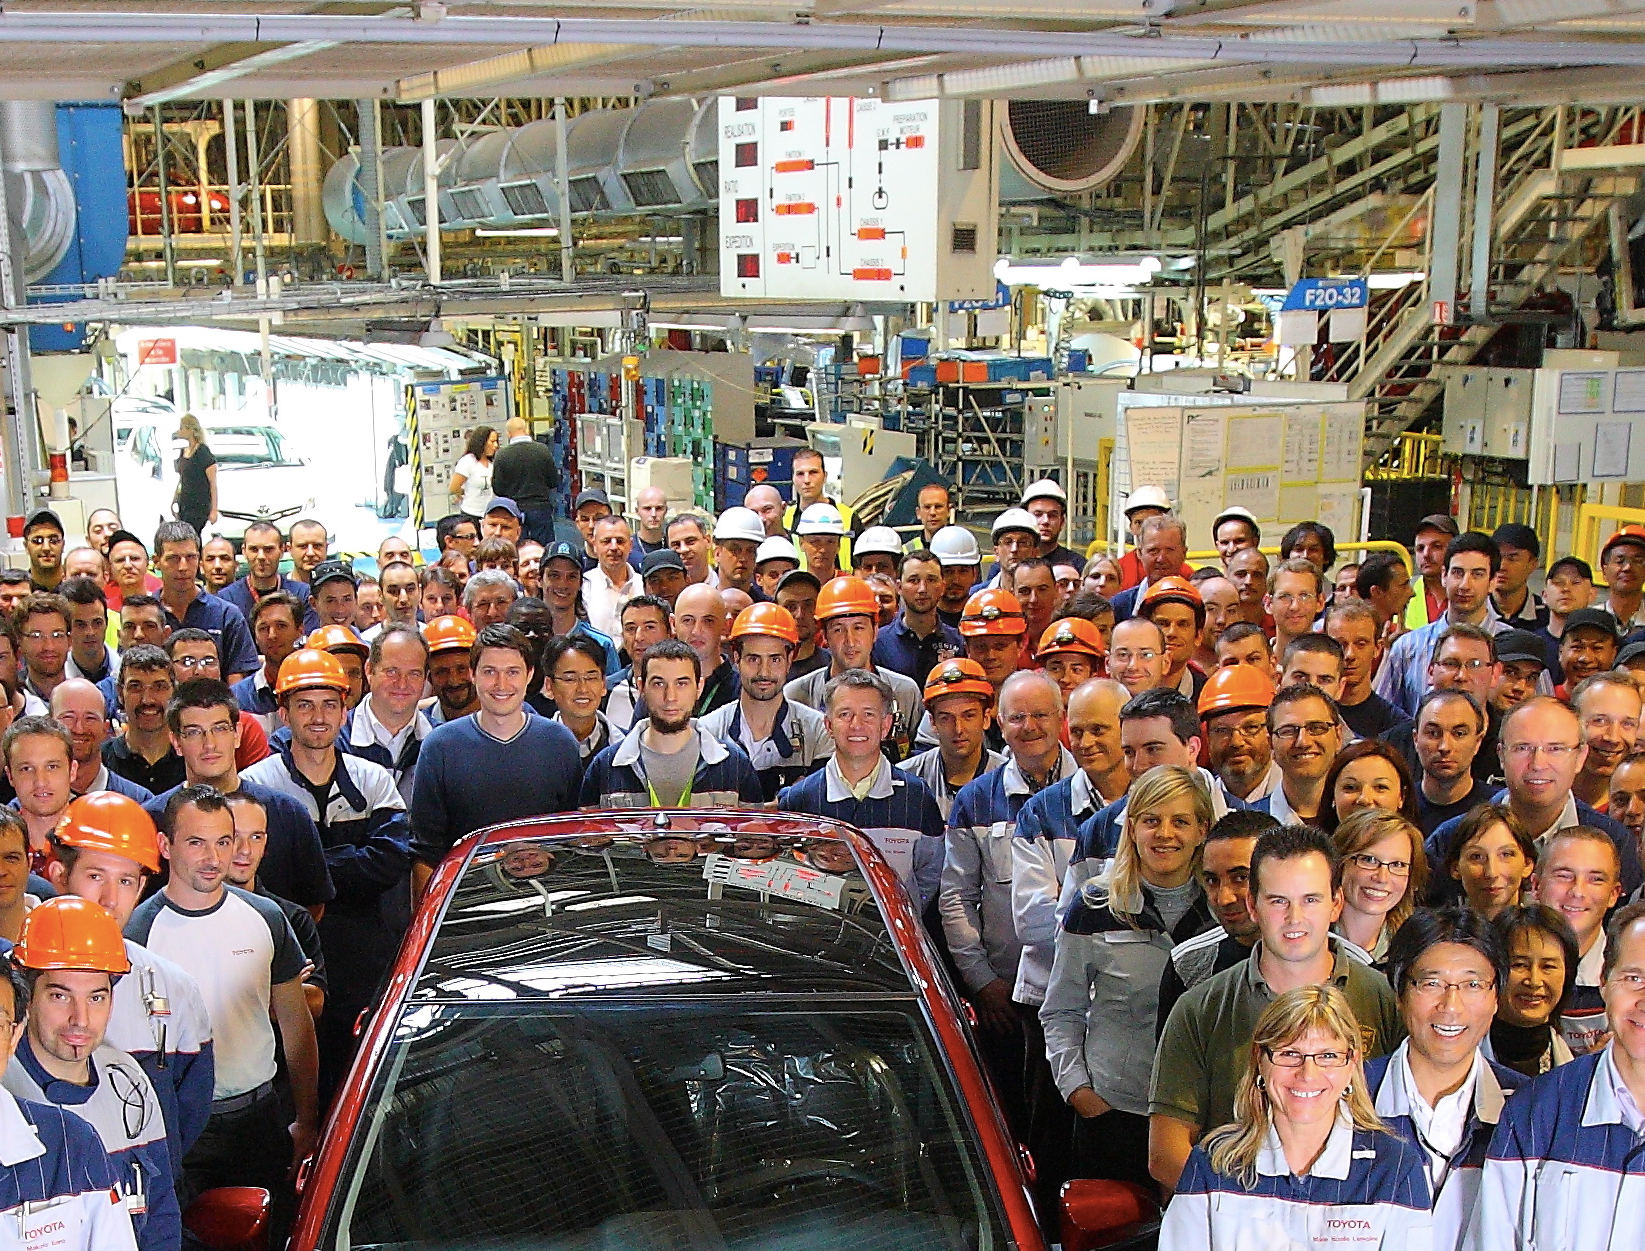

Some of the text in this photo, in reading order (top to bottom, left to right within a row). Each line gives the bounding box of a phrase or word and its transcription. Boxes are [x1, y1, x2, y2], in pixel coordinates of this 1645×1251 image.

[893, 112, 928, 123] PREPARATION
[899, 124, 921, 135] MOTEUR
[860, 218, 877, 226] CHASSIS
[860, 258, 877, 267] CHASSIS
[884, 837, 910, 845] TOYOTA
[1326, 1219, 1371, 1229] TOYOTA
[24, 1220, 66, 1240] TOYOTA
